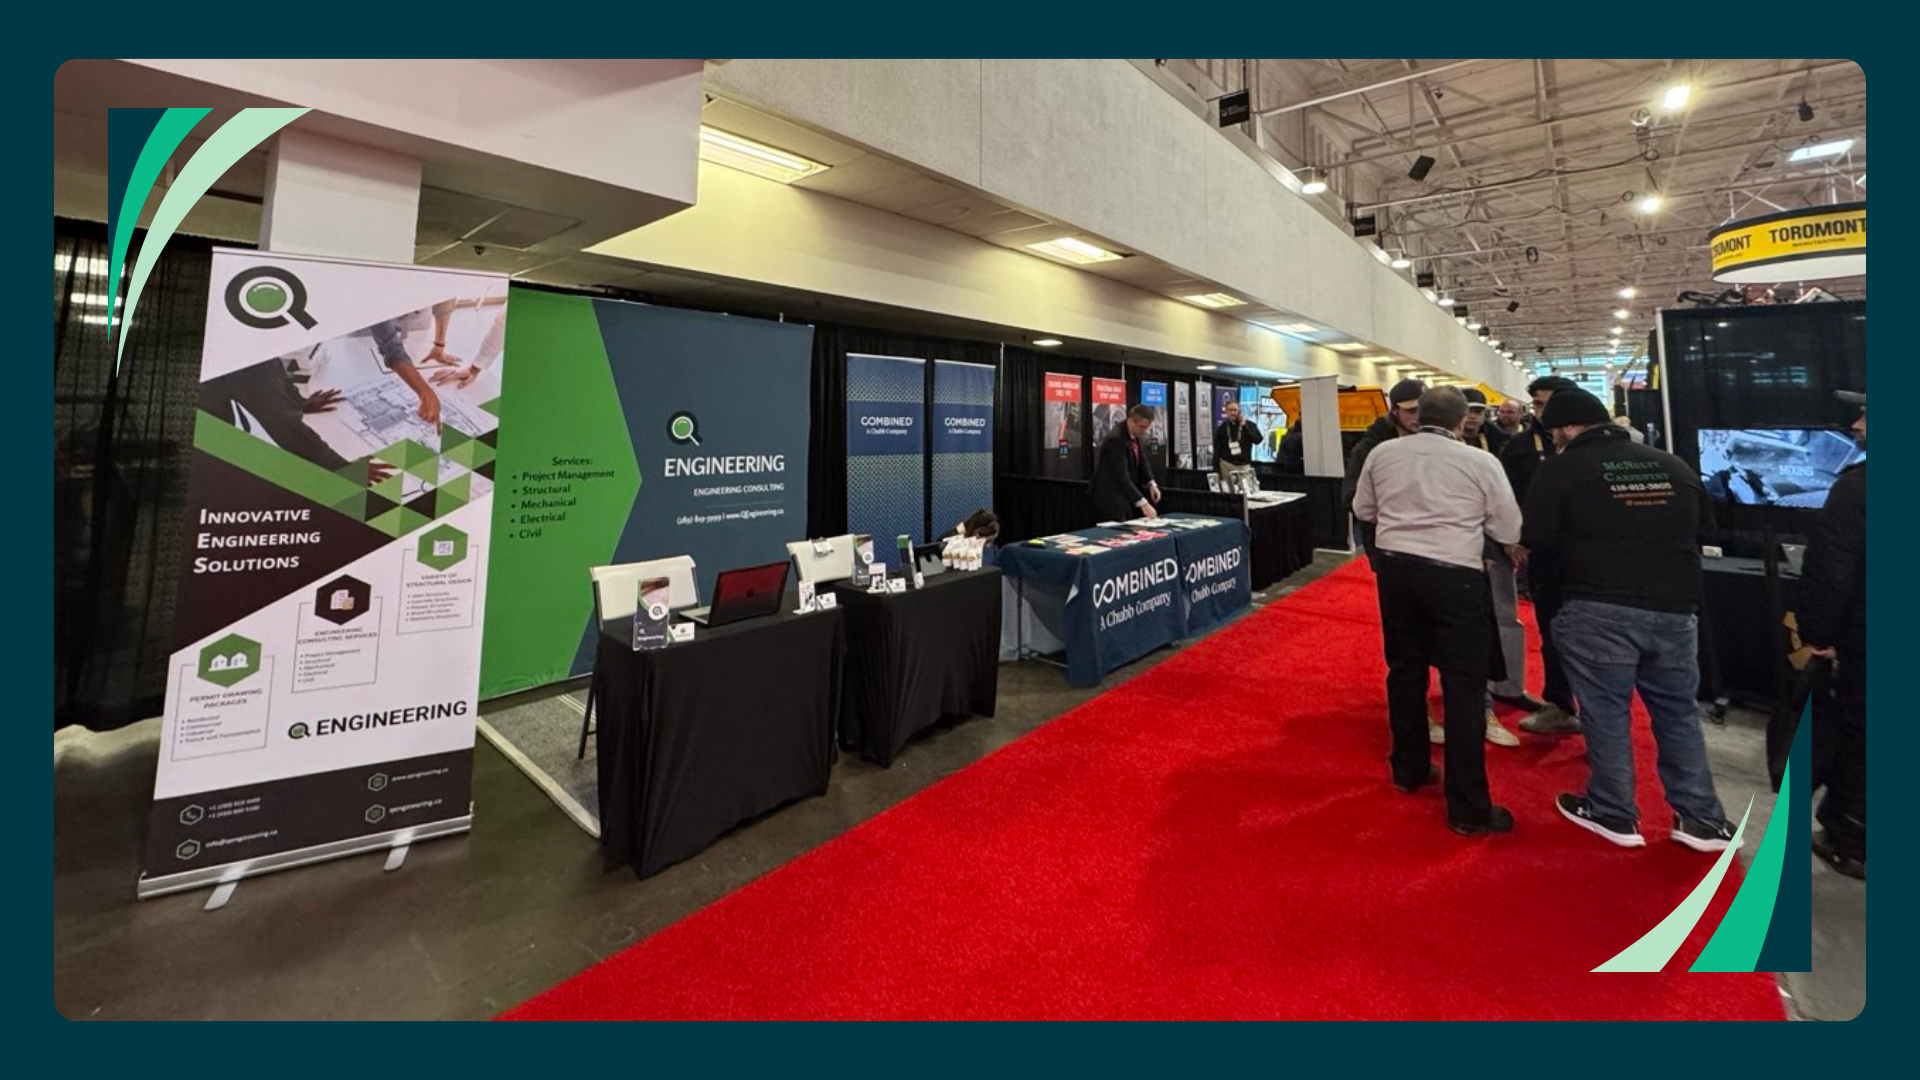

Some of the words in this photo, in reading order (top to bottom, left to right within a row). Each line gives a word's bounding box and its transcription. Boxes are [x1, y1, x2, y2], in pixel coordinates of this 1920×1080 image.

[1768, 218, 1866, 243] TOROMONT
[860, 416, 914, 427] COMBINED
[944, 417, 987, 427] COMBINED
[664, 454, 785, 478] ENGINEERING
[522, 472, 556, 482] Project
[558, 469, 615, 481] Management
[1603, 472, 1670, 482] CARPENTRY
[522, 484, 571, 495] Structural
[693, 486, 742, 497] ENGINEERING
[743, 483, 785, 493] CONSULTING
[521, 497, 577, 510] Mechanical
[200, 508, 311, 524] INNOVATIVE
[520, 512, 566, 524] Electrical
[197, 532, 321, 549] ENGINEERING
[519, 527, 542, 540] Civil
[193, 556, 300, 573] SOLUTIONS
[1183, 548, 1240, 584] OMBINED
[1093, 557, 1178, 609] COMBINED
[1191, 584, 1210, 604] Chubb
[1211, 577, 1237, 595] Company
[1100, 615, 1106, 631] A
[1106, 604, 1135, 627] Chubb
[1135, 591, 1171, 616] Company
[190, 693, 220, 702] PERMIT
[222, 688, 262, 699] DRAWING
[203, 698, 247, 708] PACKAGES
[316, 700, 467, 736] ENGINEERING
